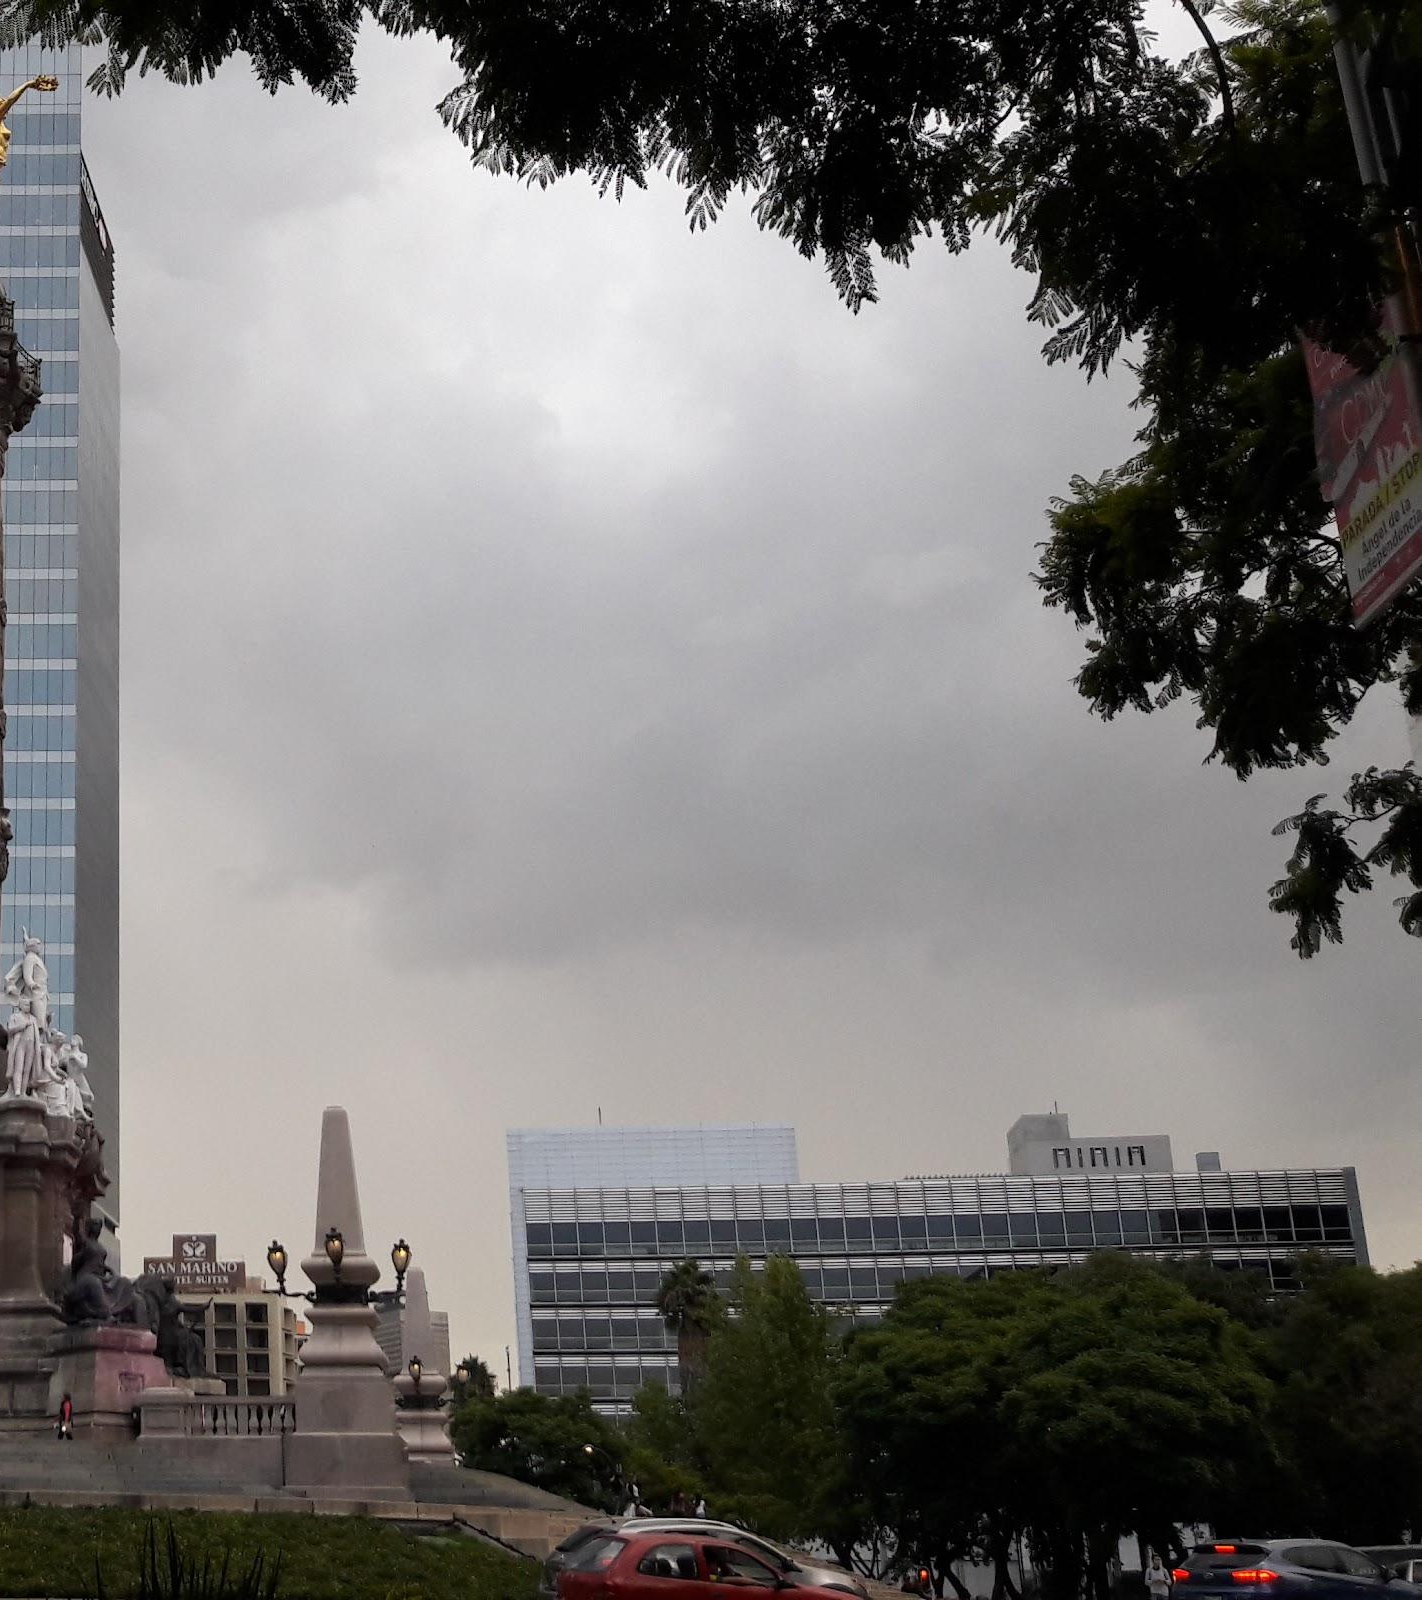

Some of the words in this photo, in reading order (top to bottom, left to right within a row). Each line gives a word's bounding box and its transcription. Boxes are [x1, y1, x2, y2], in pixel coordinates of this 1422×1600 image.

[1342, 495, 1381, 549] PARADA
[1388, 509, 1400, 528] de
[1400, 497, 1412, 515] la
[147, 1262, 176, 1274] SAN
[180, 1261, 238, 1274] MARINO
